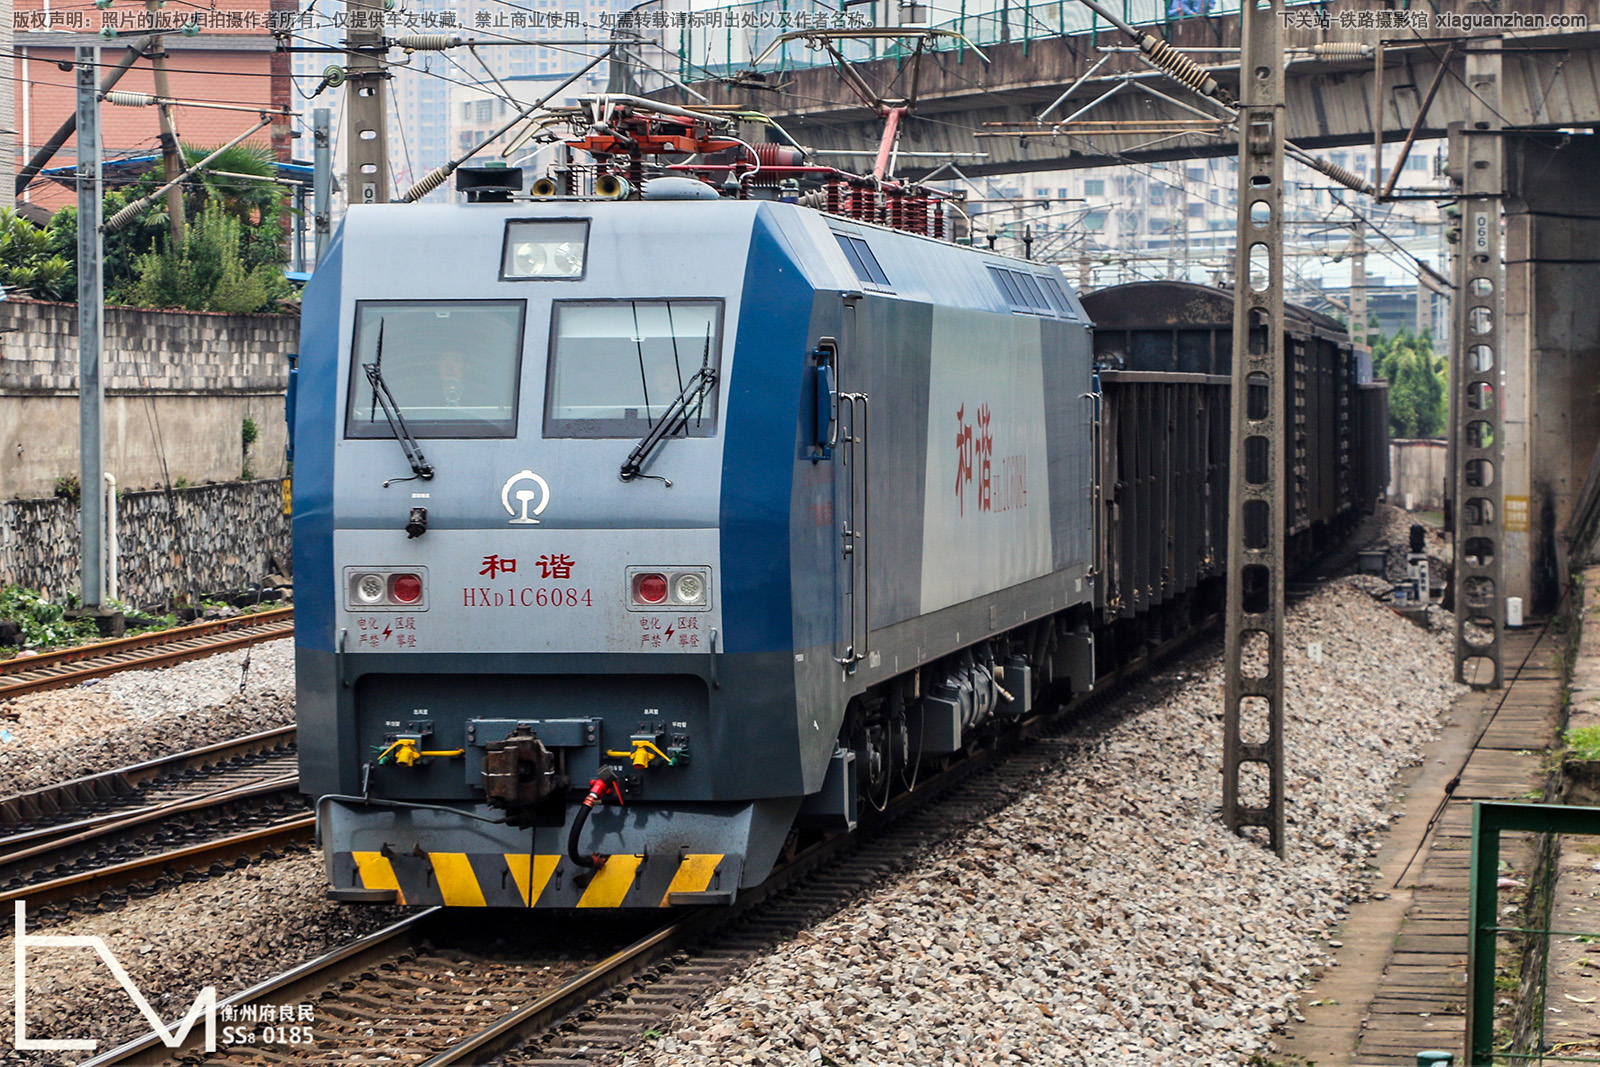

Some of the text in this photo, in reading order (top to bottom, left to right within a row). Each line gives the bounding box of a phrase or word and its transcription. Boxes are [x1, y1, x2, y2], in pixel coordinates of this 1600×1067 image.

[1477, 216, 1486, 247] 066
[955, 402, 992, 518] 和谐
[479, 553, 576, 579] 和谐
[463, 588, 593, 606] HXD1C6084
